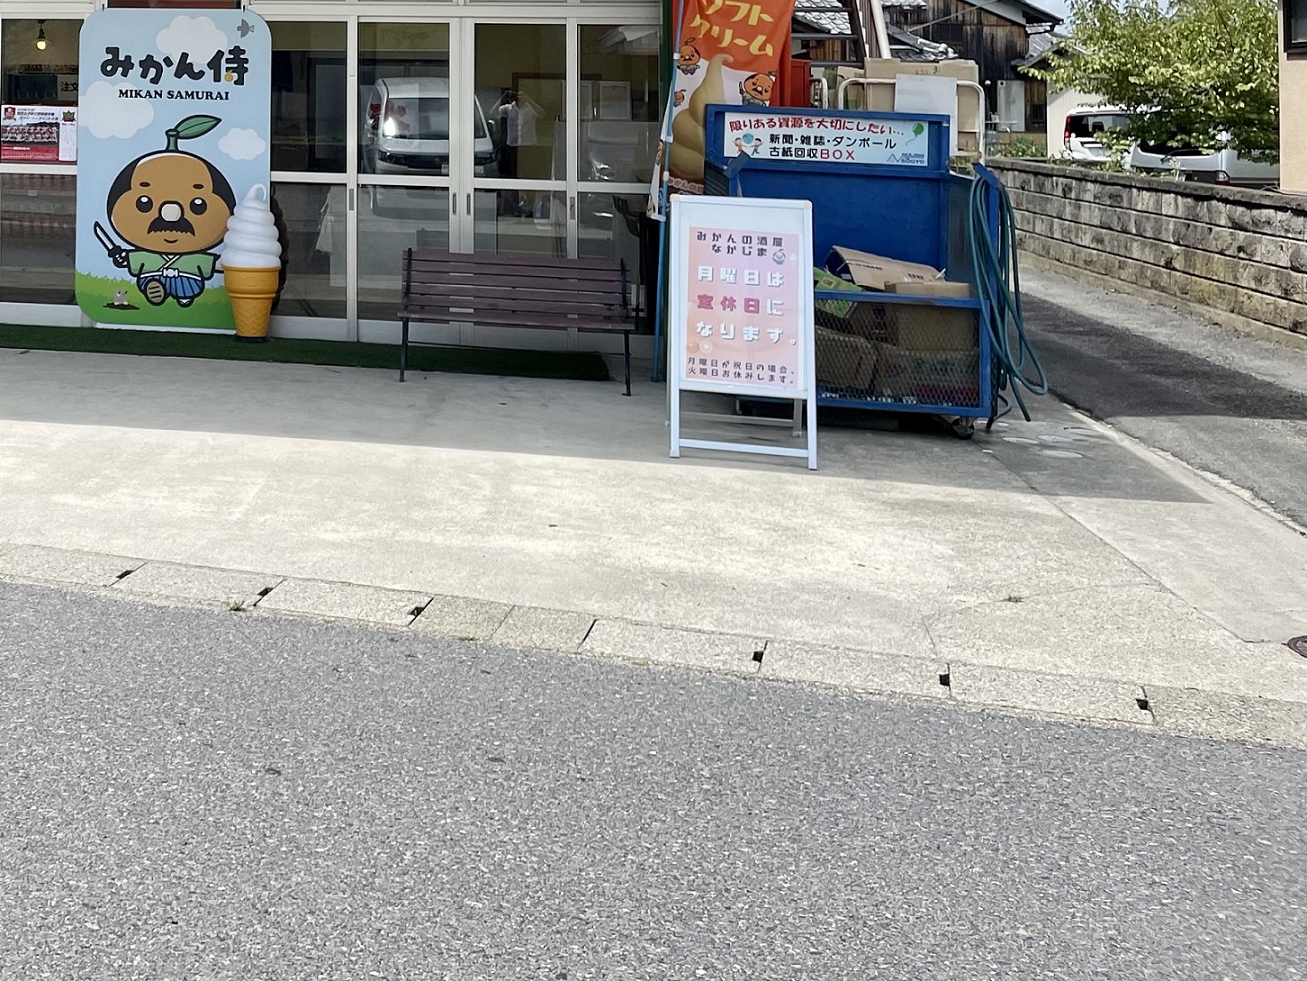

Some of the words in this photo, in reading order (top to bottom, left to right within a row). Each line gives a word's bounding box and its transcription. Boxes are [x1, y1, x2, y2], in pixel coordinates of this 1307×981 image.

[689, 14, 774, 57] クリーム
[100, 46, 249, 86] みかん侍
[118, 88, 163, 100] MIKAN
[166, 89, 230, 101] SAMURAI
[769, 133, 897, 150] 新聞・雑誌・ダンボール
[696, 231, 783, 247] みかんの酒屋
[712, 244, 767, 257] なかじま
[697, 266, 784, 288] 月曜日は
[697, 294, 784, 316] 定休日に
[696, 321, 797, 346] なります。
